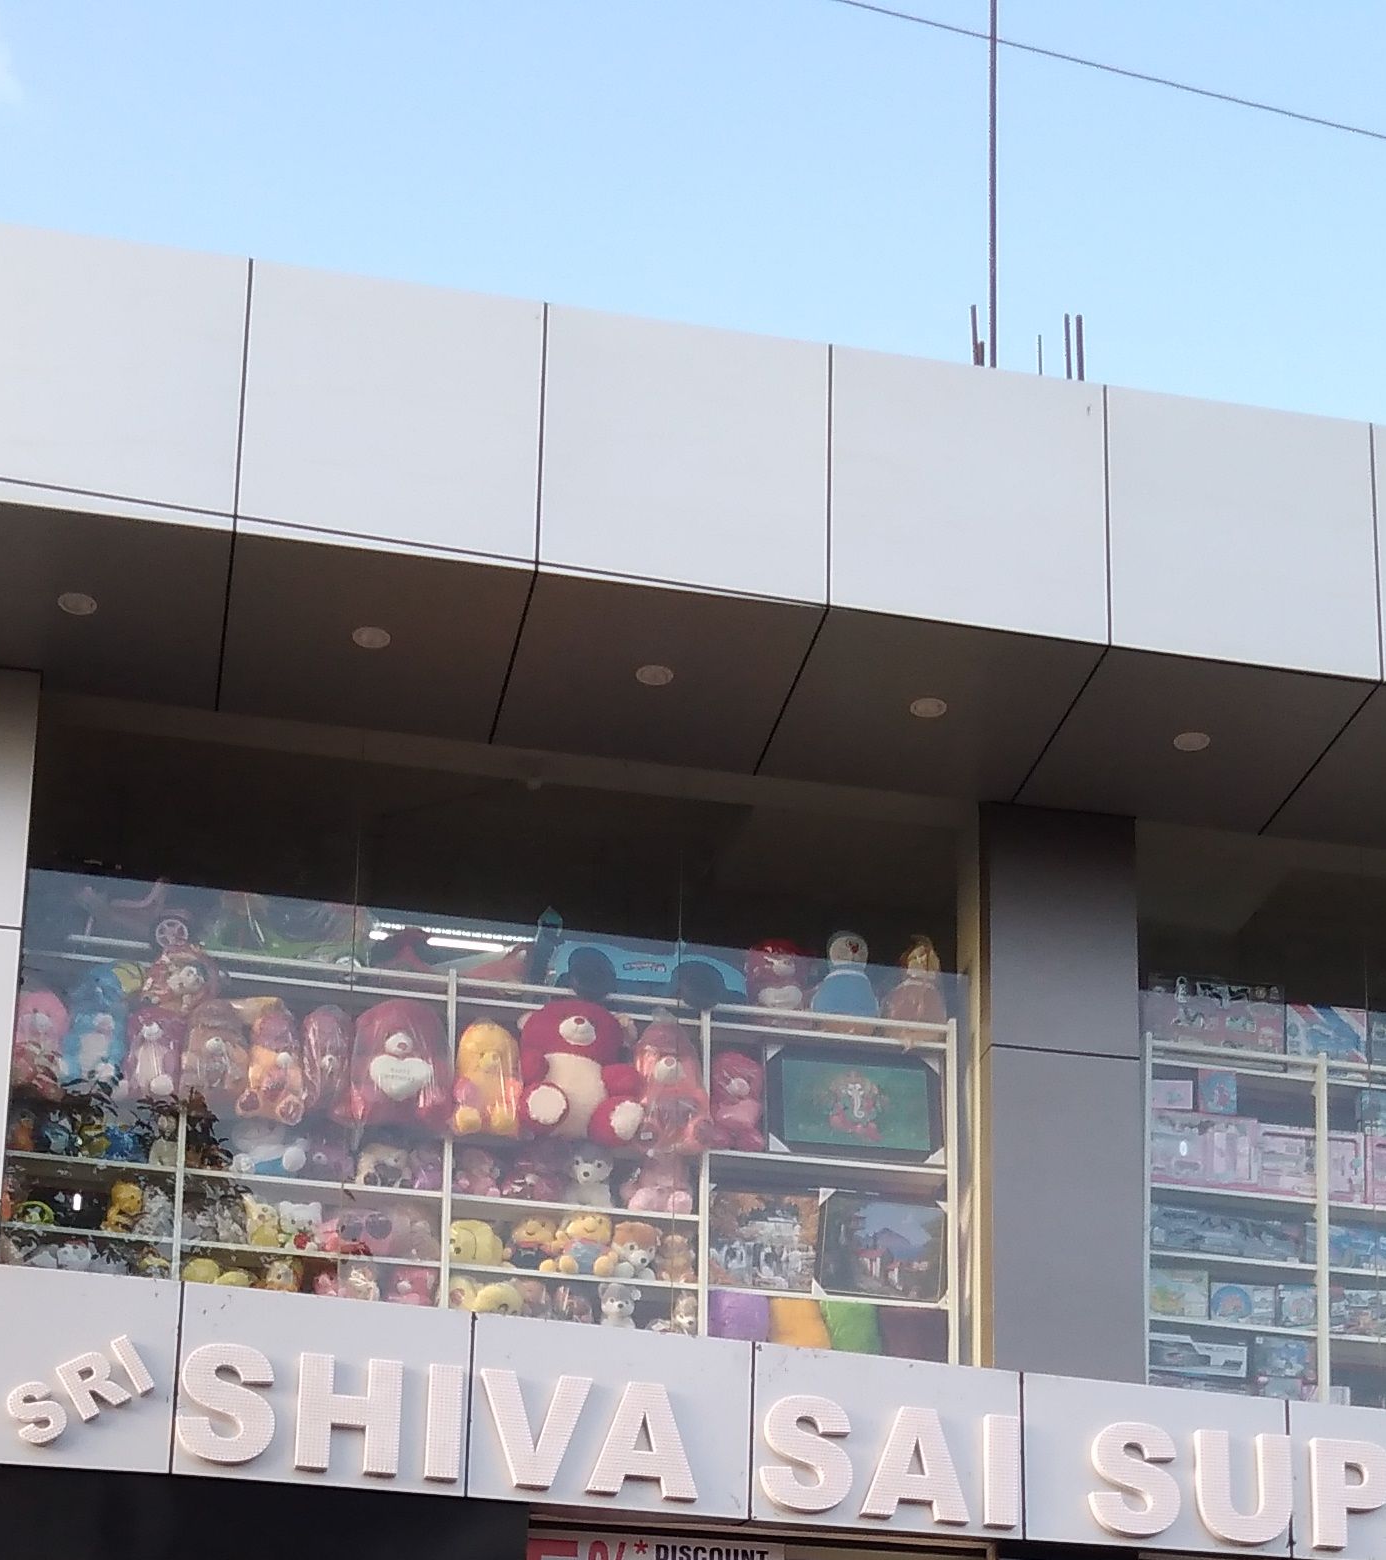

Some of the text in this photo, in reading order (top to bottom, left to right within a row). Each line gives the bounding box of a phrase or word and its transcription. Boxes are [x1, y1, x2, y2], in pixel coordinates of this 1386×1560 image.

[6, 1334, 154, 1446] SRI
[176, 1342, 698, 1502] SHIVA
[759, 1393, 1020, 1529] SAI
